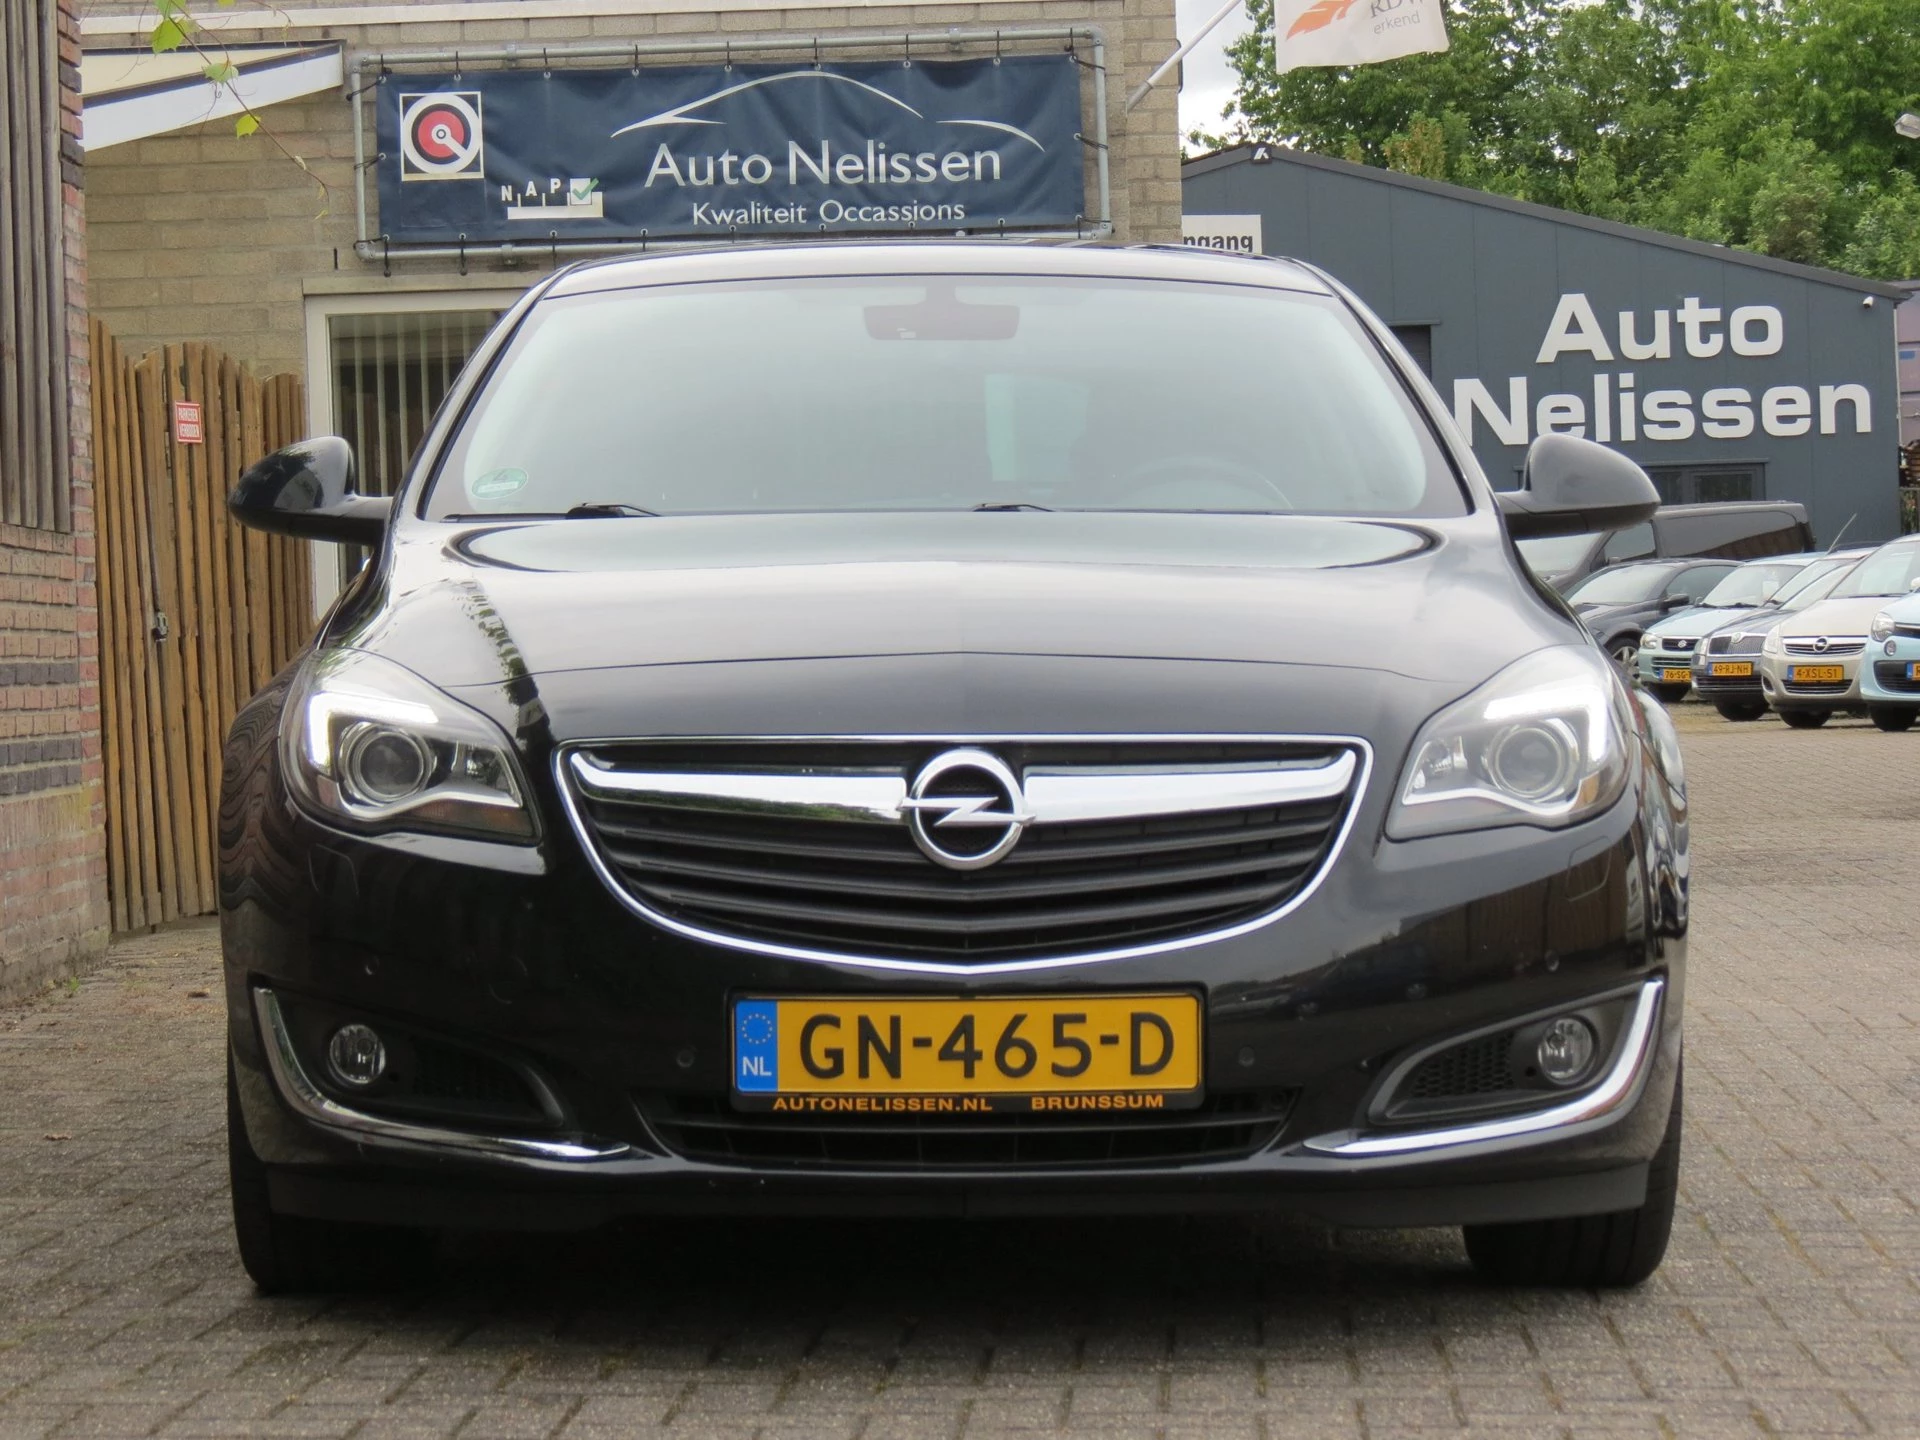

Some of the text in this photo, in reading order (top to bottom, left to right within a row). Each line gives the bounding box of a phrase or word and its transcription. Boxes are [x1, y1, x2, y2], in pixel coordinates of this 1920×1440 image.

[1373, 11, 1421, 35] erkend
[644, 139, 1001, 188] Auto Nelissen
[692, 199, 966, 226] Kwaliteit Occassions
[1535, 293, 1784, 364] Auto
[1453, 372, 1872, 446] Nelissen
[742, 1010, 1175, 1079] NL GN-465-D
[773, 1094, 1164, 1112] AUTONELISSEN.NL BRUNSSUM
